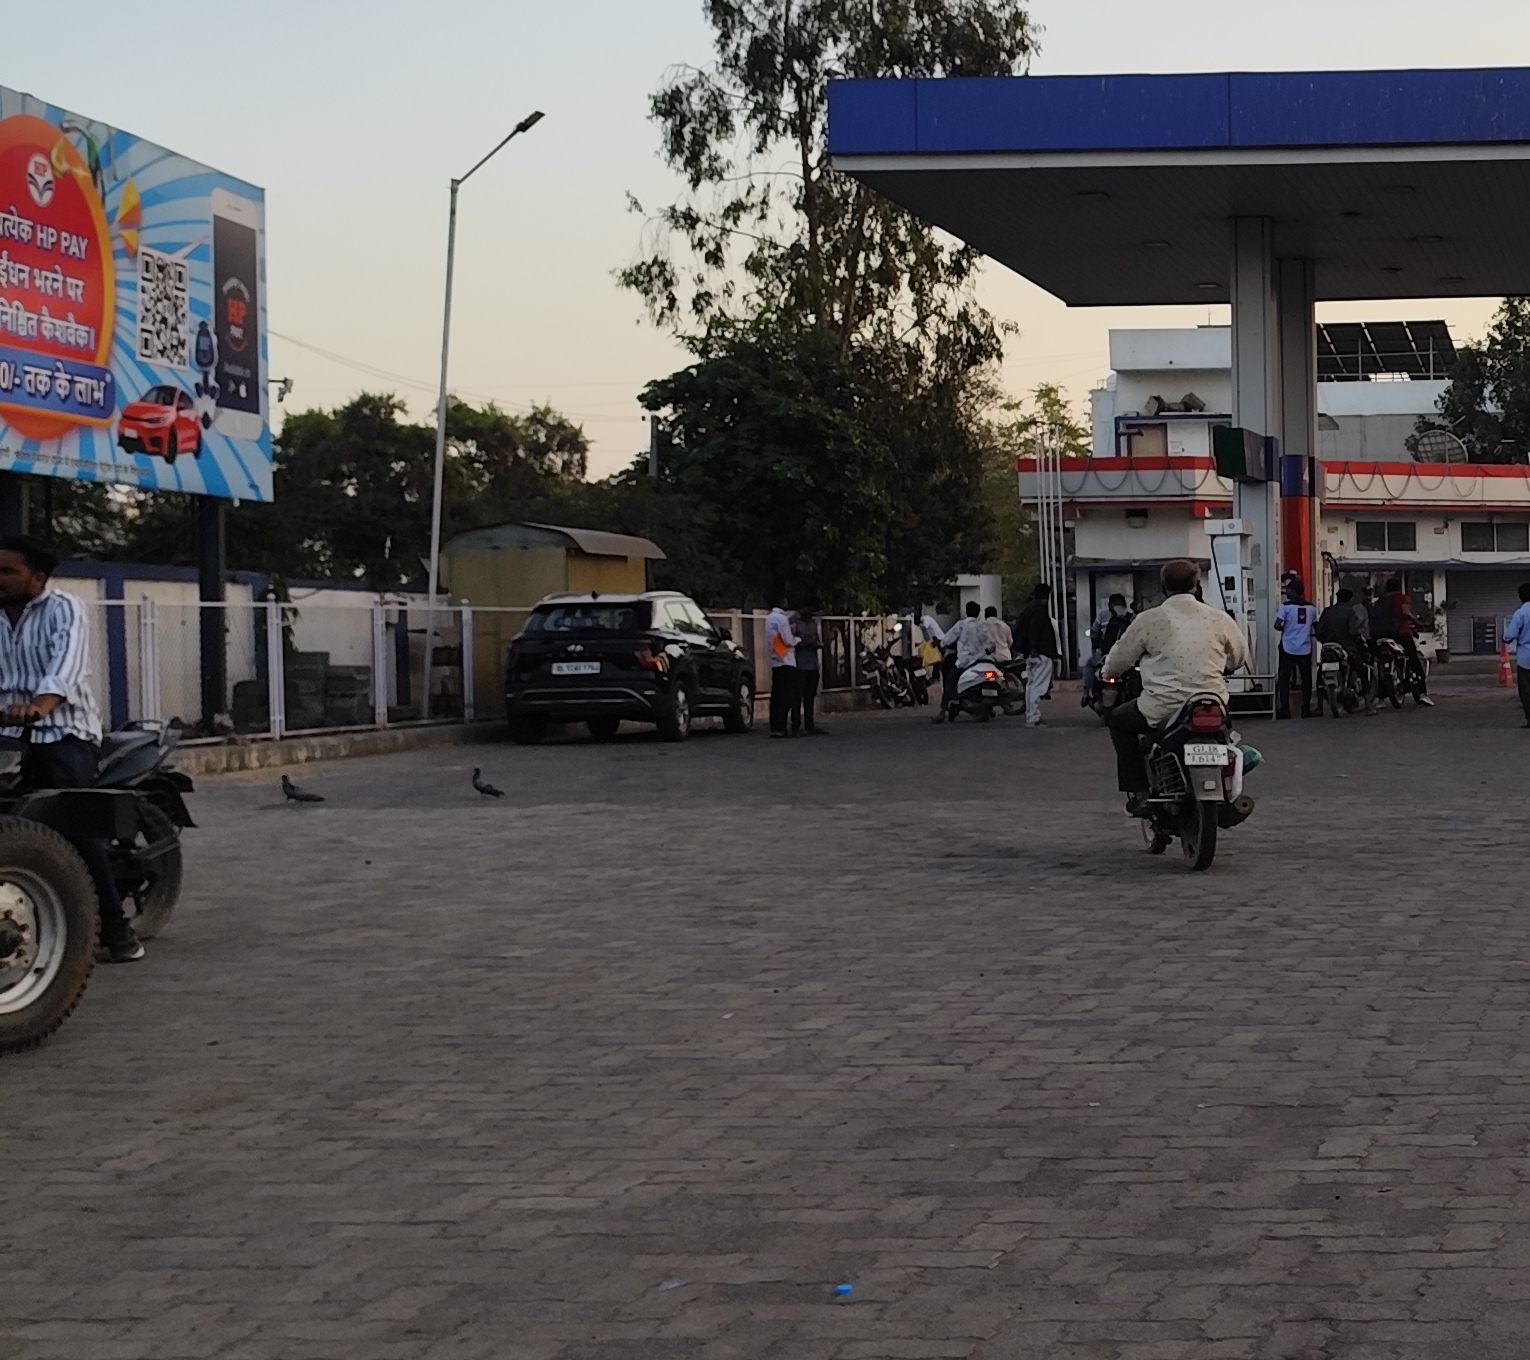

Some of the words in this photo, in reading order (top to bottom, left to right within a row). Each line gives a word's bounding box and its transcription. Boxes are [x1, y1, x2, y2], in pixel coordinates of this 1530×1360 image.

[37, 224, 58, 250] HP
[60, 231, 89, 261] PAY
[33, 265, 64, 299] भरने
[66, 276, 85, 303] पर
[23, 365, 53, 397] तक
[54, 361, 72, 400] के
